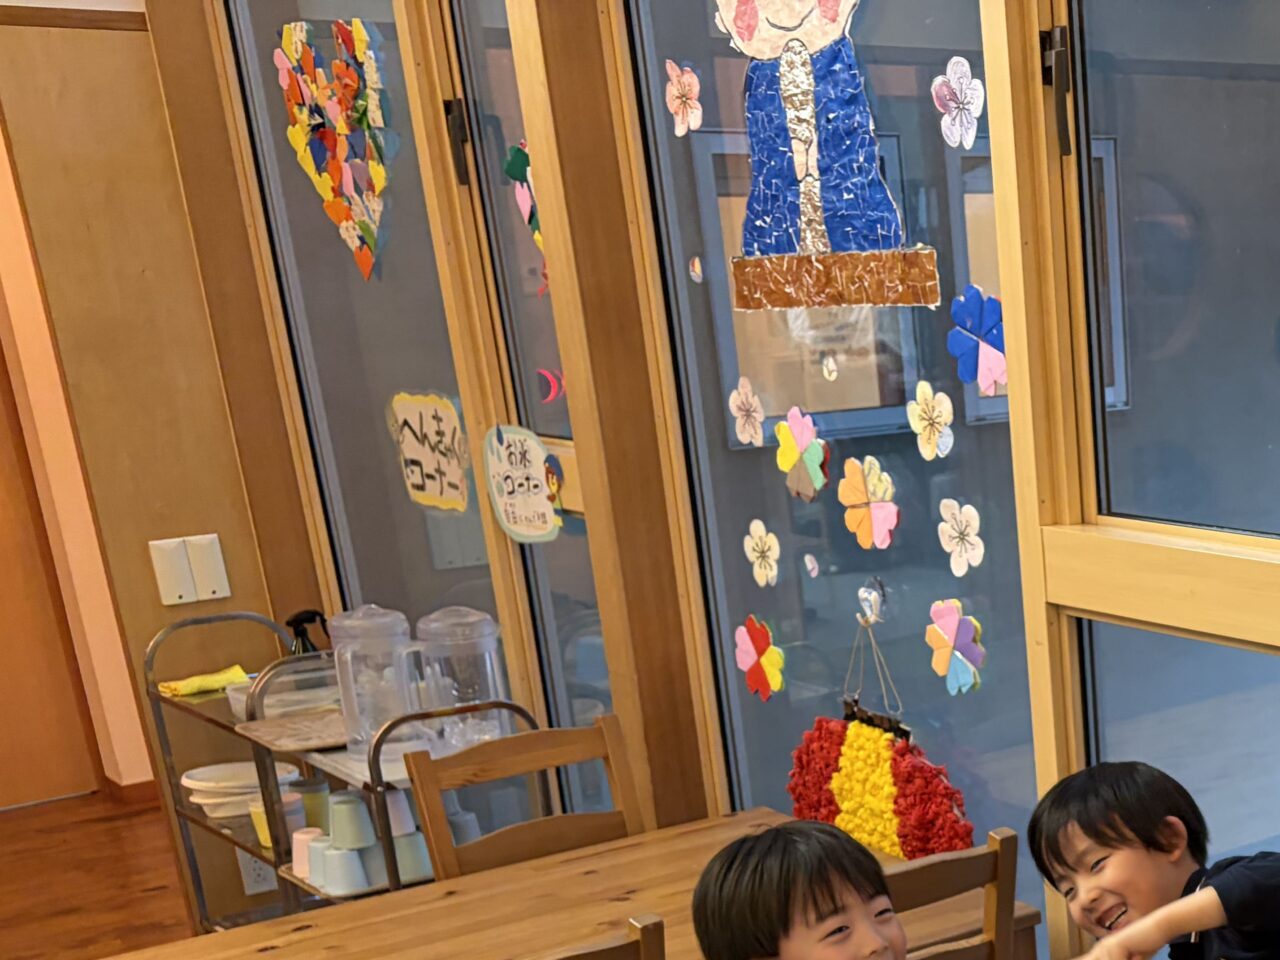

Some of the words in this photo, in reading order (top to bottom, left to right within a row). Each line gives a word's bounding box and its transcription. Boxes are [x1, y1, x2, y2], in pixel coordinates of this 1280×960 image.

[400, 408, 461, 466] へんきゃく
[404, 458, 460, 496] コーナー
[503, 475, 540, 495] コーナー
